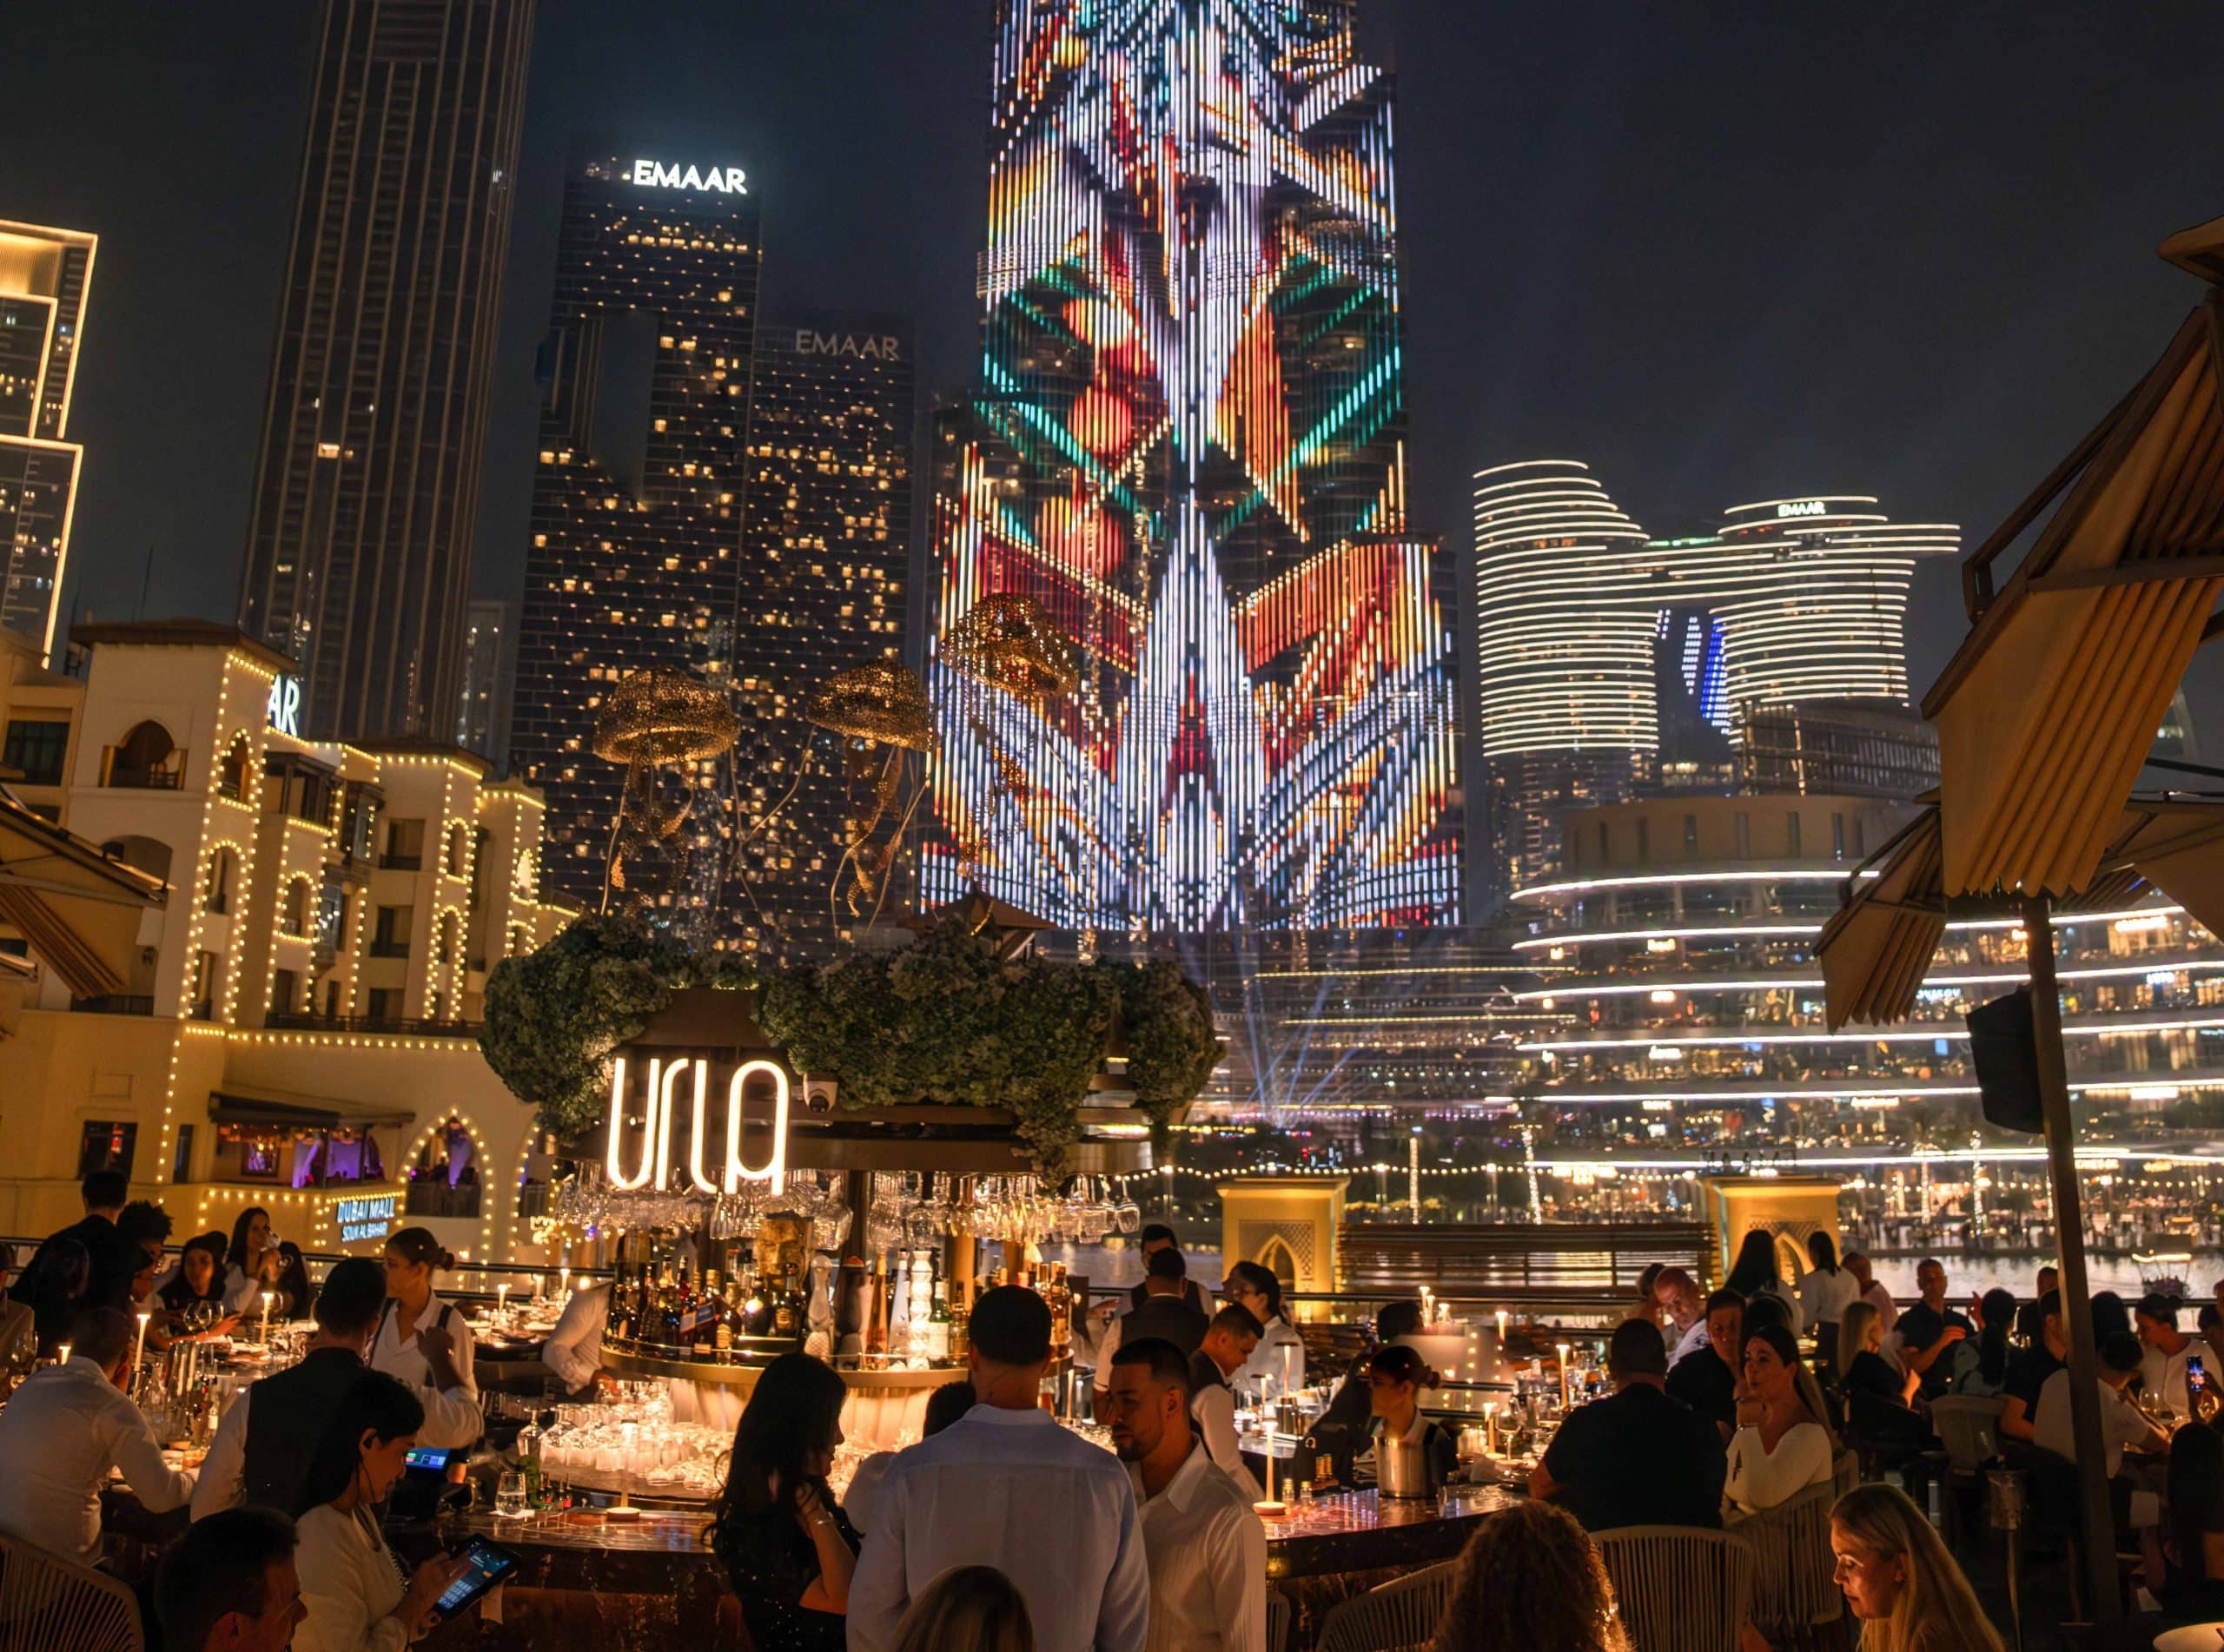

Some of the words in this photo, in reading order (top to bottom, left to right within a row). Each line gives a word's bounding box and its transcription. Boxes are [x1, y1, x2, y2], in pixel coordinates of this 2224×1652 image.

[633, 159, 747, 195] EMAAR
[795, 329, 900, 361] EMAAR
[1778, 501, 1826, 517] EMAAR
[337, 1200, 369, 1223] DUBAI
[369, 1198, 394, 1219] MALL
